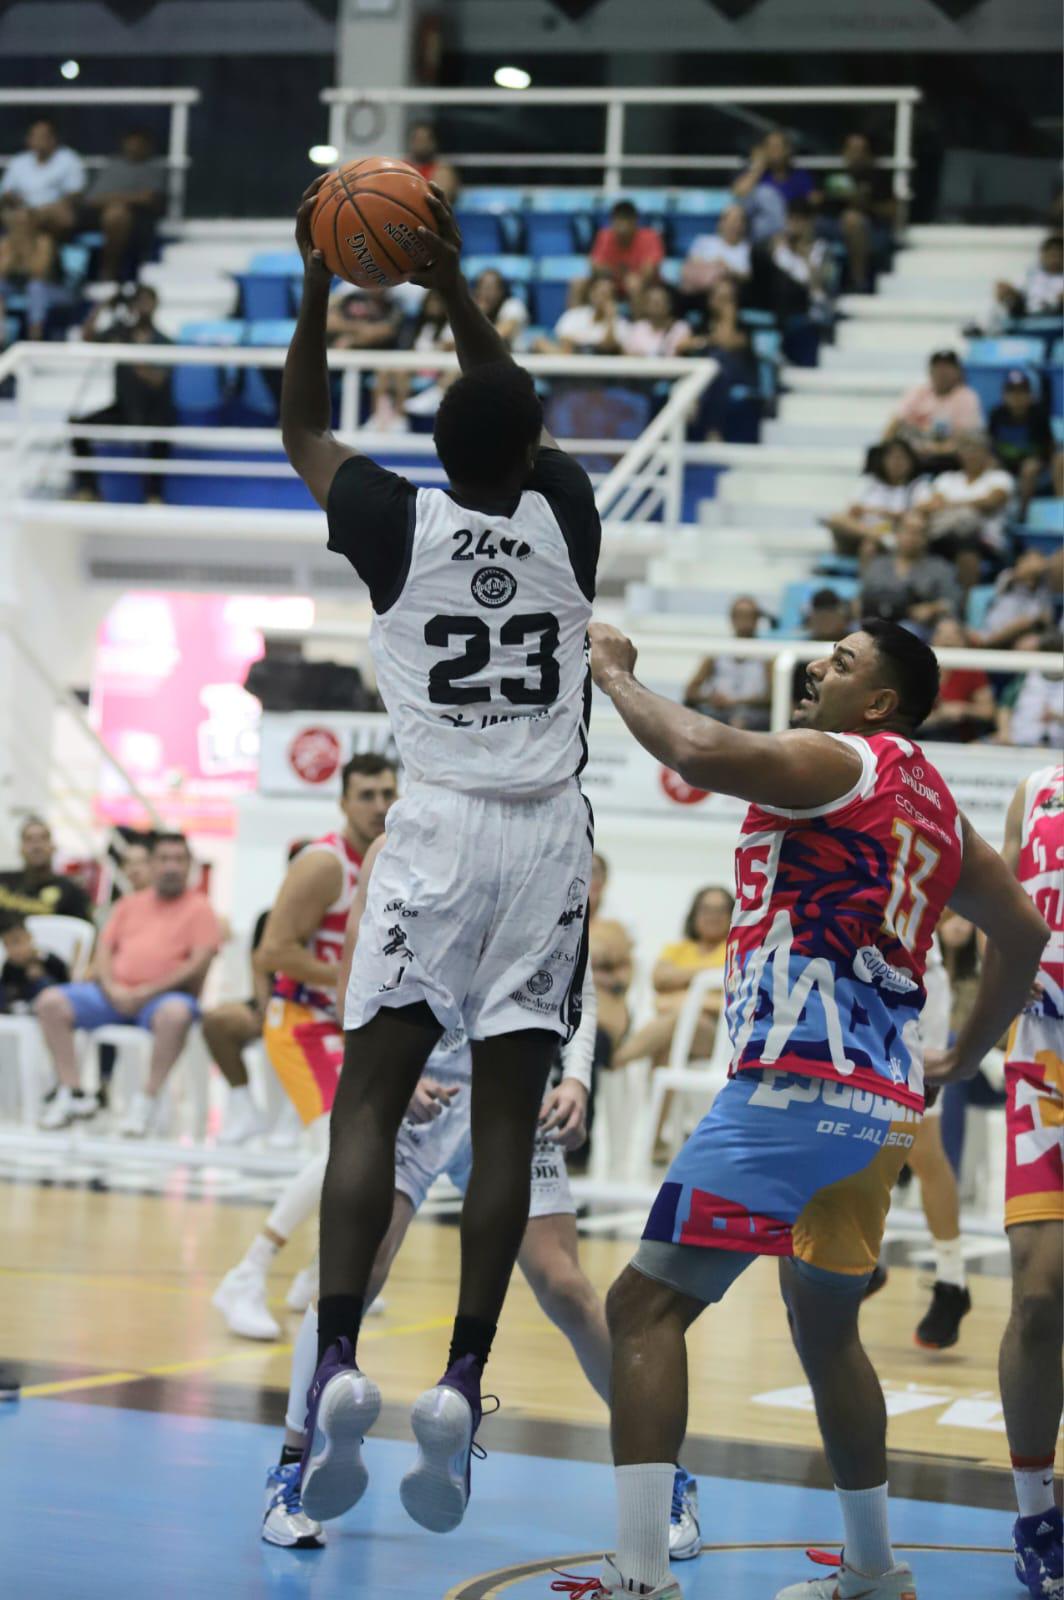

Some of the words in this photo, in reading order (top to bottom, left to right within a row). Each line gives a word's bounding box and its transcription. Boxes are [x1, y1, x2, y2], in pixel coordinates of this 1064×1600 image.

[423, 611, 560, 706] 23
[898, 766, 942, 811] SPALDING
[880, 816, 941, 951] 13
[816, 1119, 850, 1137] DE
[853, 1125, 915, 1149] JALISCO
